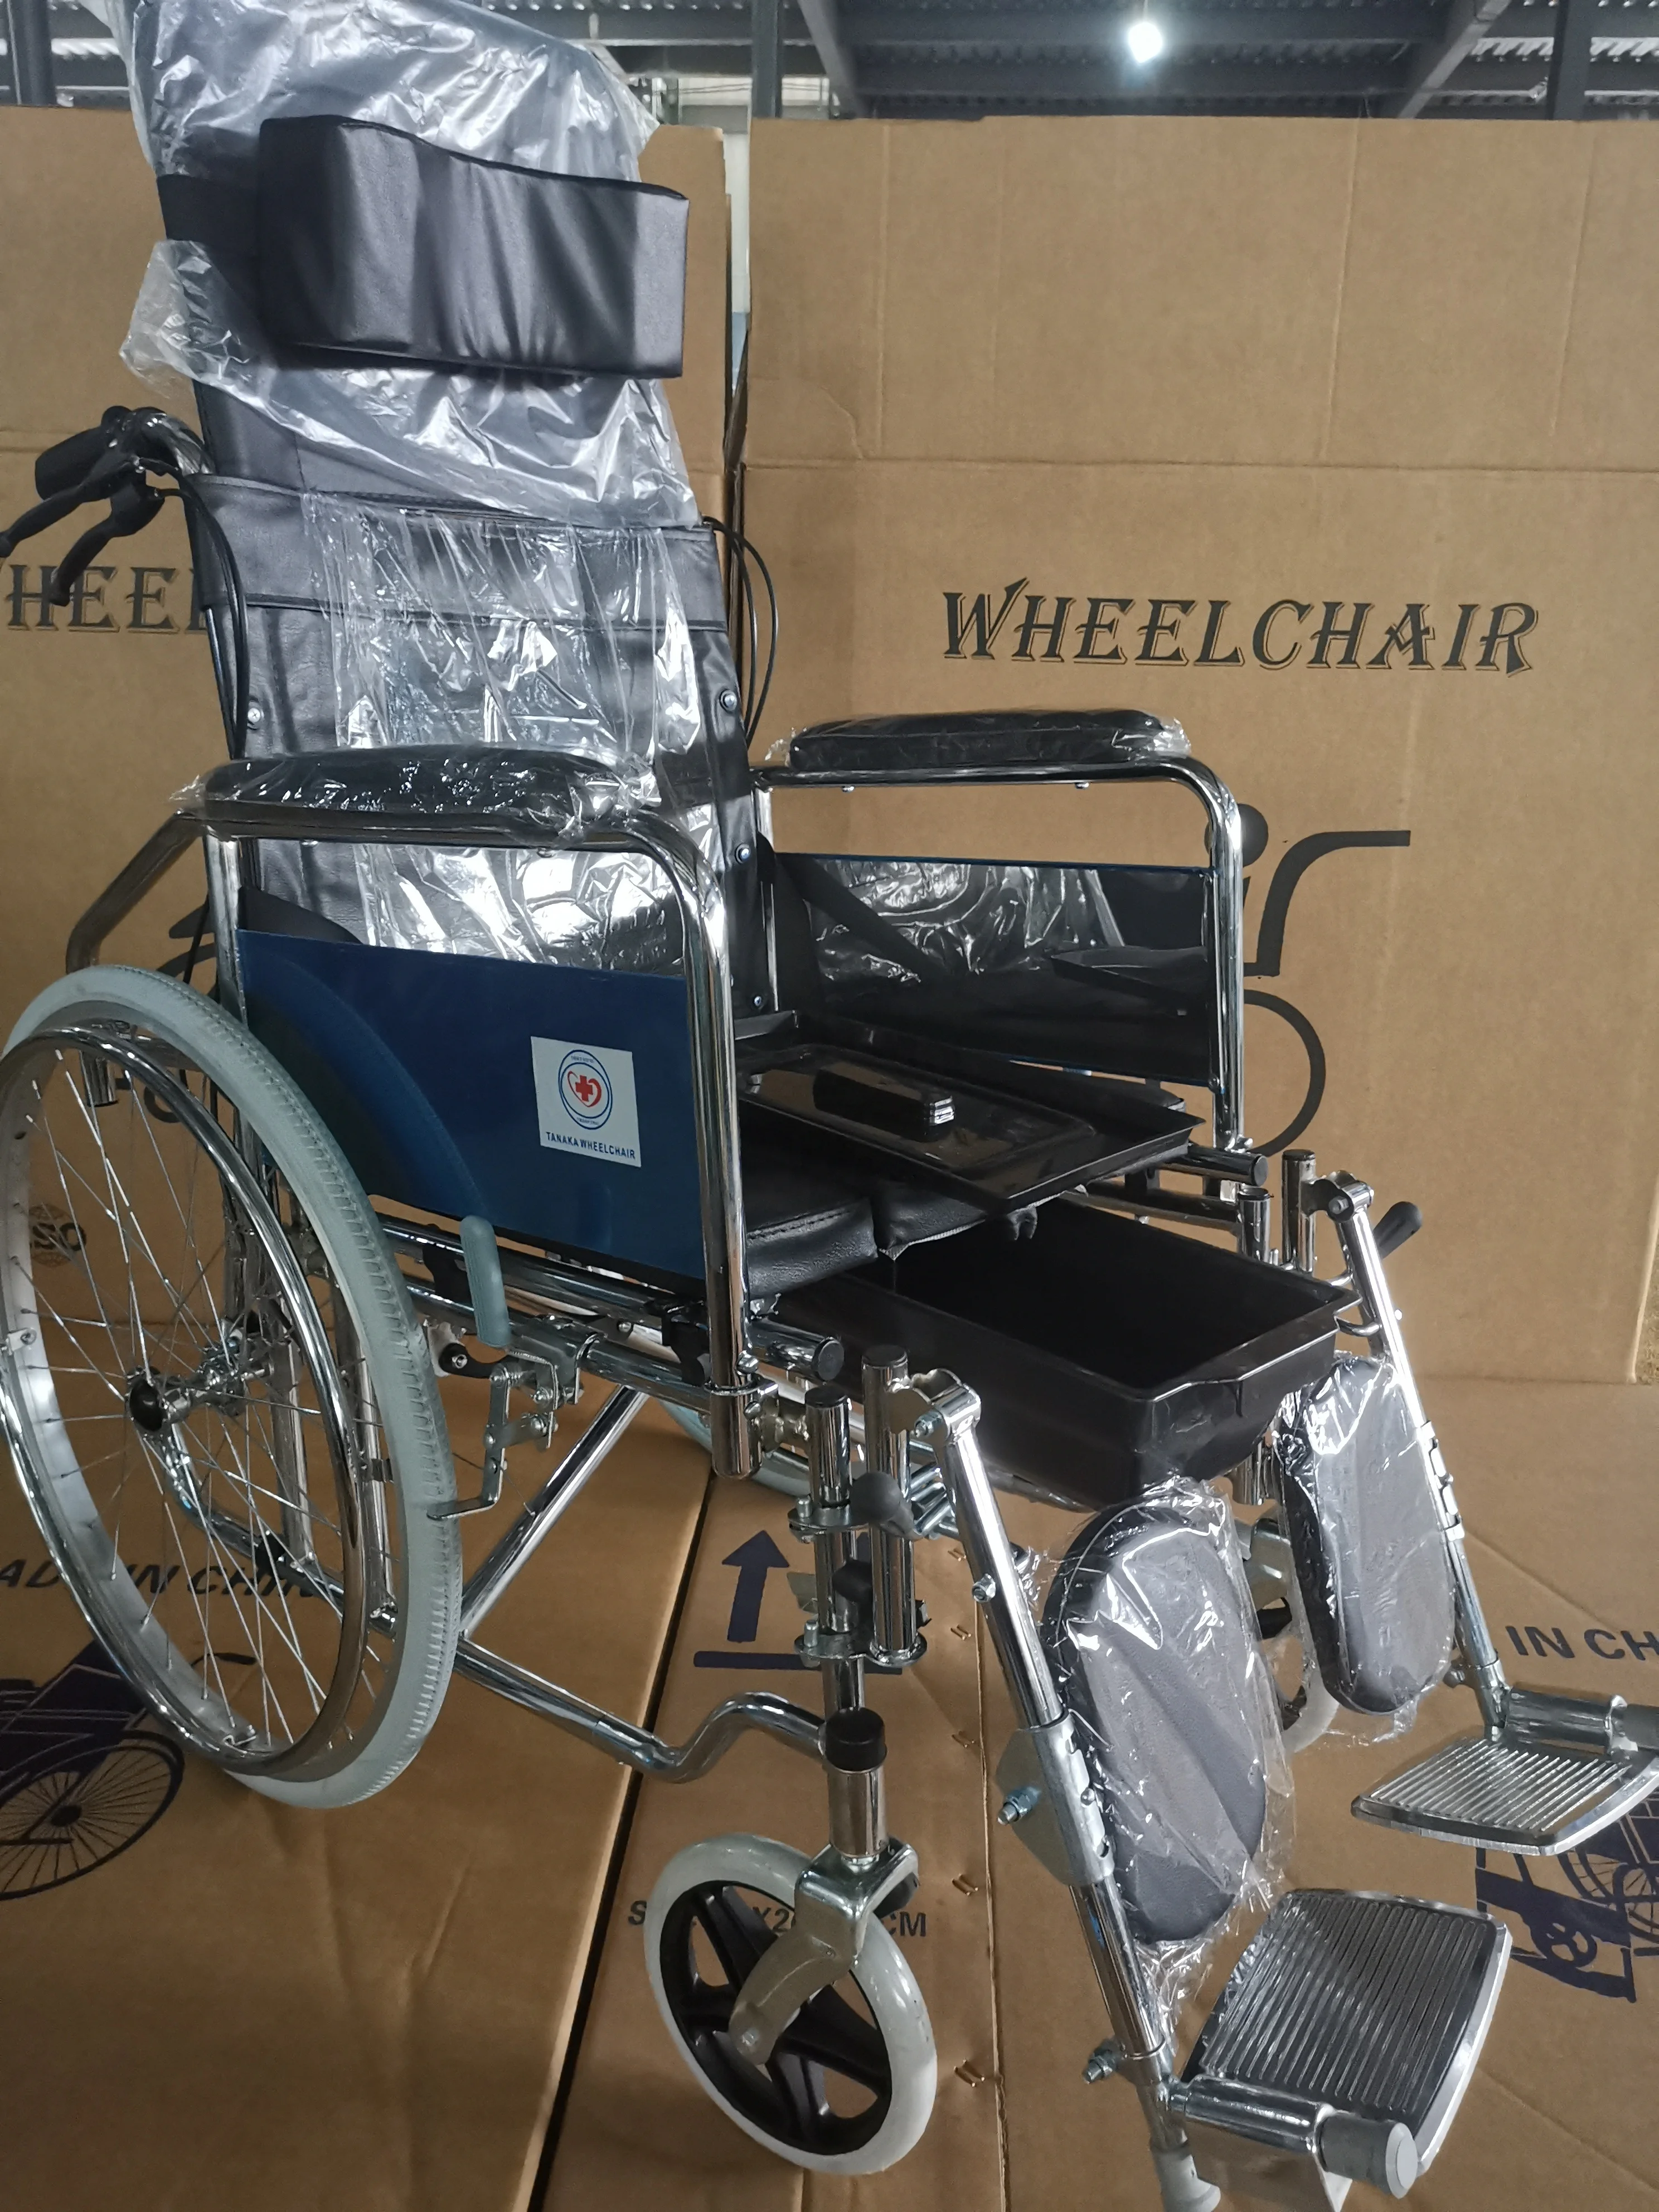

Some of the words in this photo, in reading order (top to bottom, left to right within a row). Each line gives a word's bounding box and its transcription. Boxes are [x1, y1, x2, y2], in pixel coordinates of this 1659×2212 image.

[943, 577, 1539, 678] WHEELCHAIR
[546, 1131, 579, 1148] TANAKA
[579, 1138, 636, 1160] WHEELCHAIR
[1505, 1626, 1576, 1658] IN
